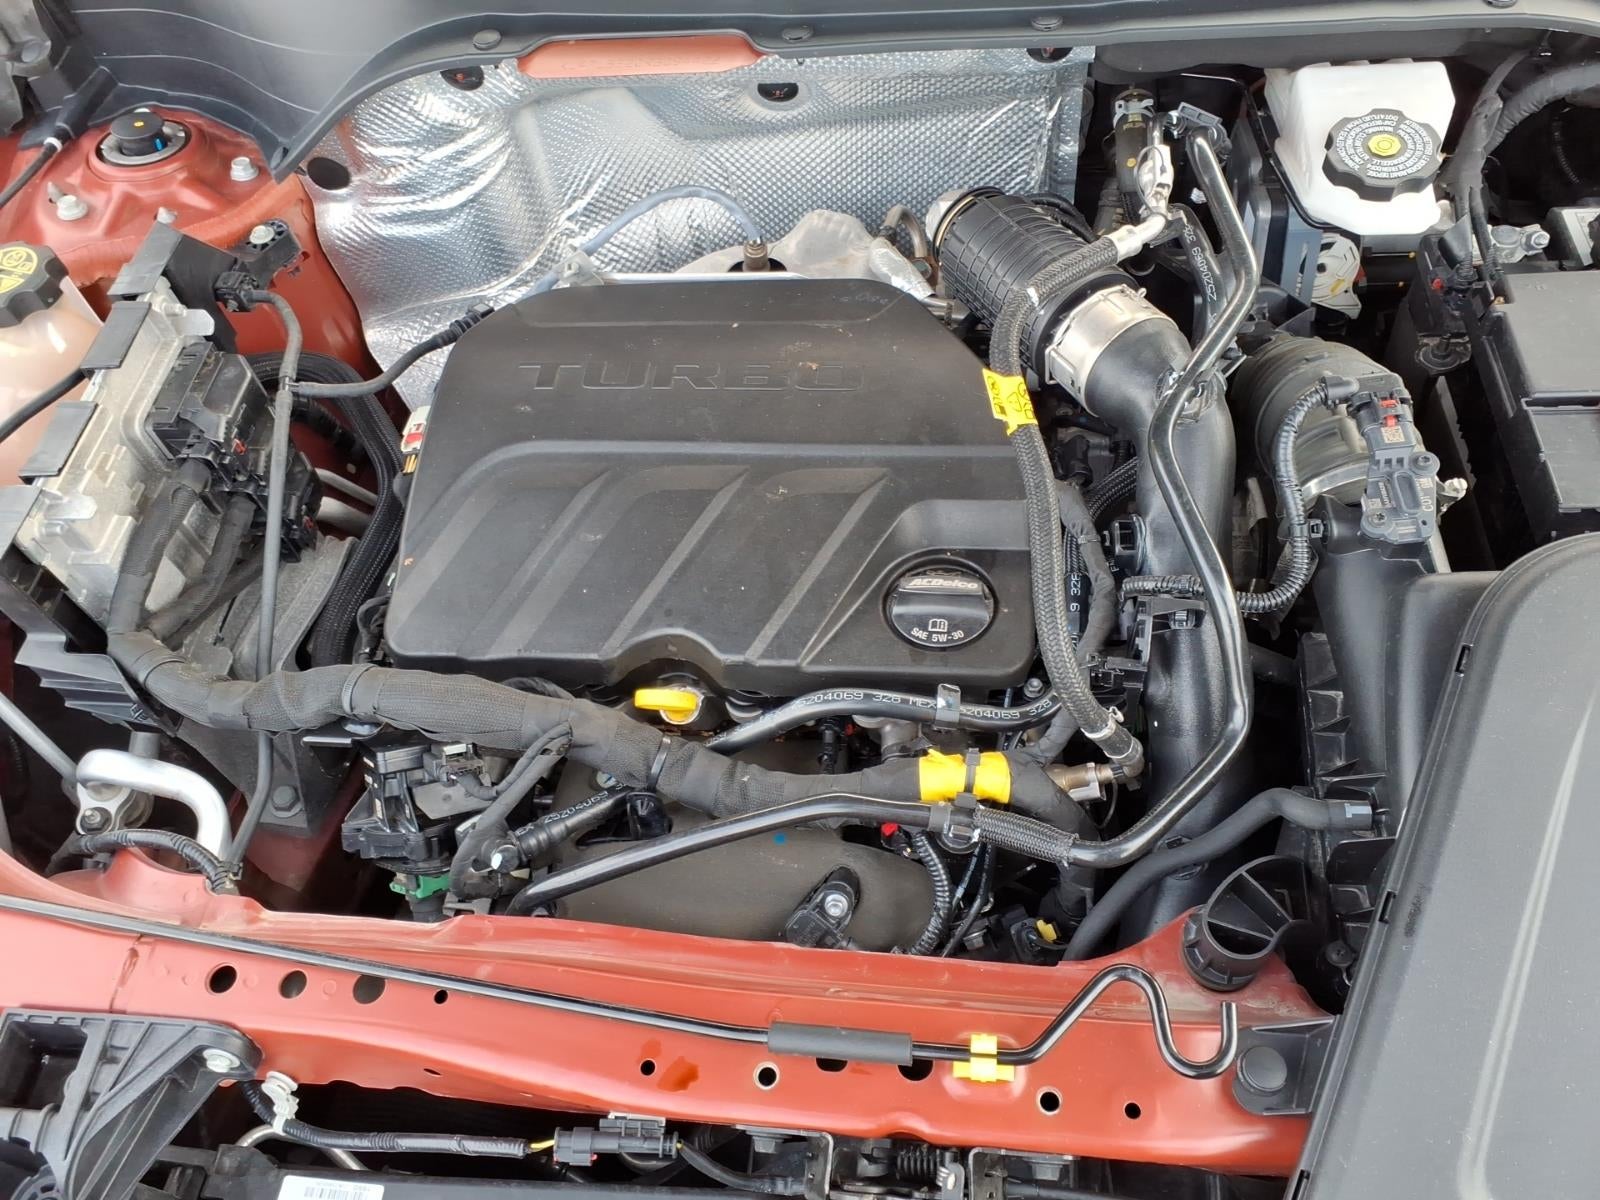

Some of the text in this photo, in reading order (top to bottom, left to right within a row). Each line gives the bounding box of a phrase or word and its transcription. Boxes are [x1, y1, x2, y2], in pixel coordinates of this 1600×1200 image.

[518, 360, 865, 391] TURBO
[906, 578, 979, 589] ACDelco
[911, 627, 965, 642] SAE 5W-30
[872, 692, 901, 704] 328
[909, 698, 937, 710] MEX
